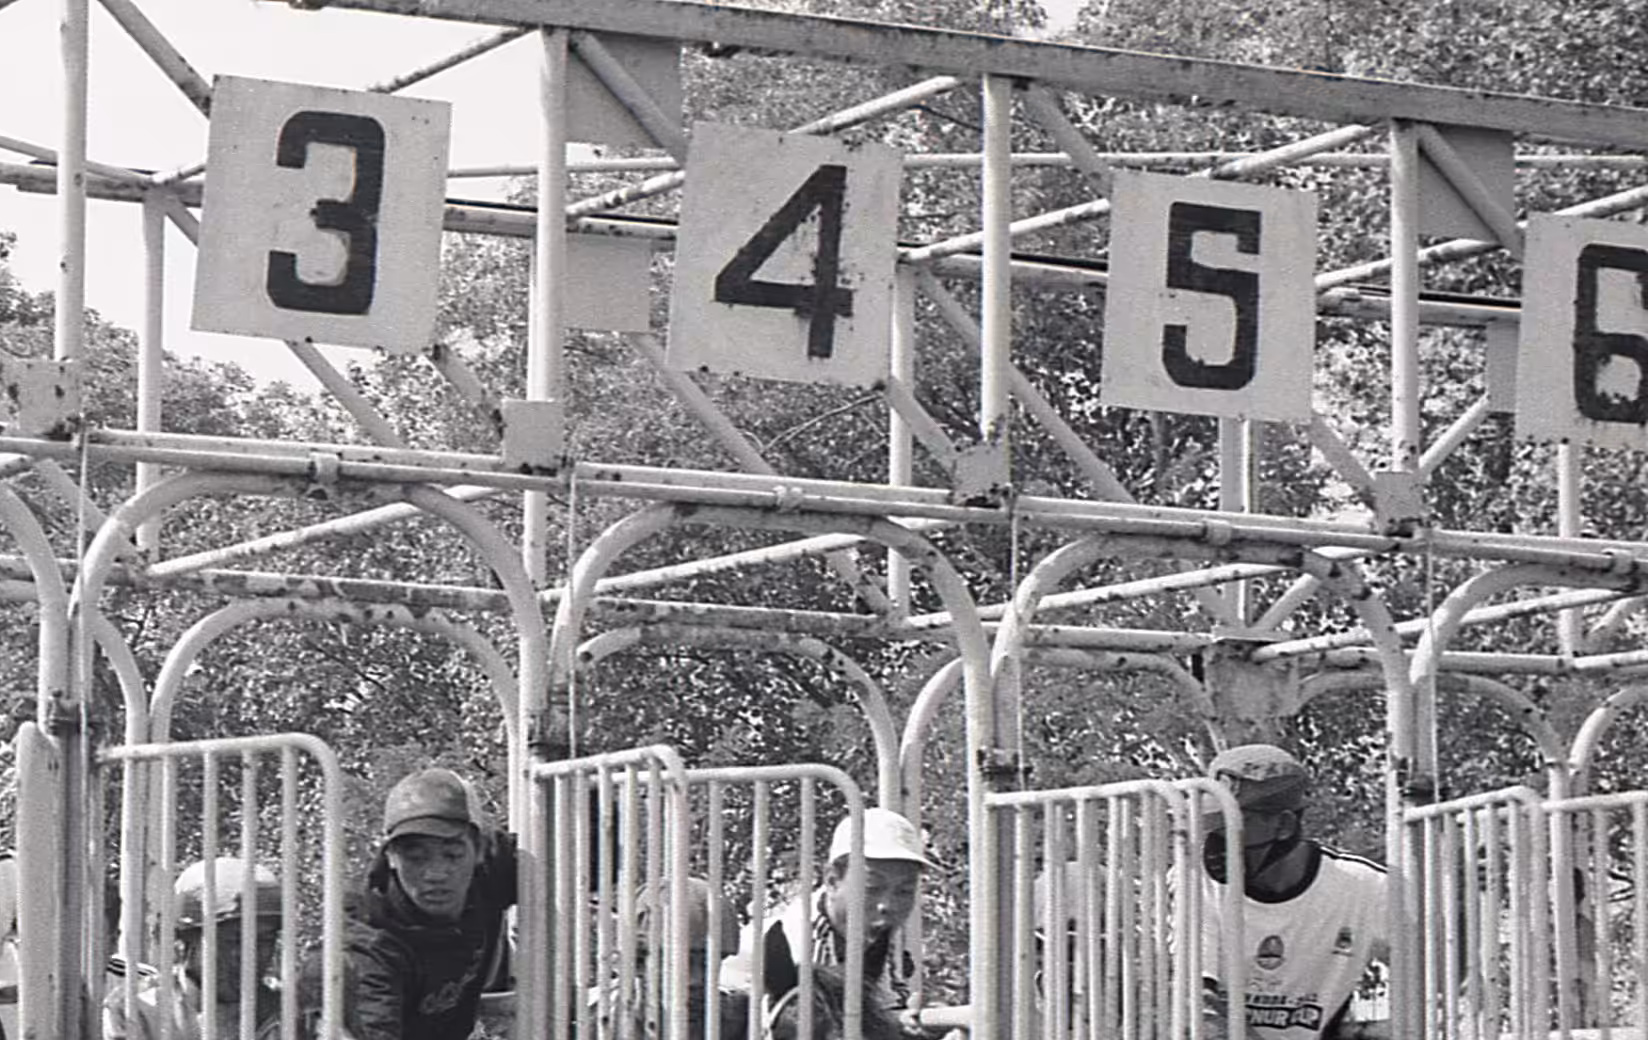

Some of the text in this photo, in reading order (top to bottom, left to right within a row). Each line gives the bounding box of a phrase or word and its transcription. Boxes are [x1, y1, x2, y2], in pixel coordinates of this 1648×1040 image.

[266, 110, 386, 316] 3
[713, 164, 854, 358] 4
[1162, 201, 1261, 391] 5
[1573, 243, 1648, 424] 6
[1245, 1008, 1288, 1027] NUR
